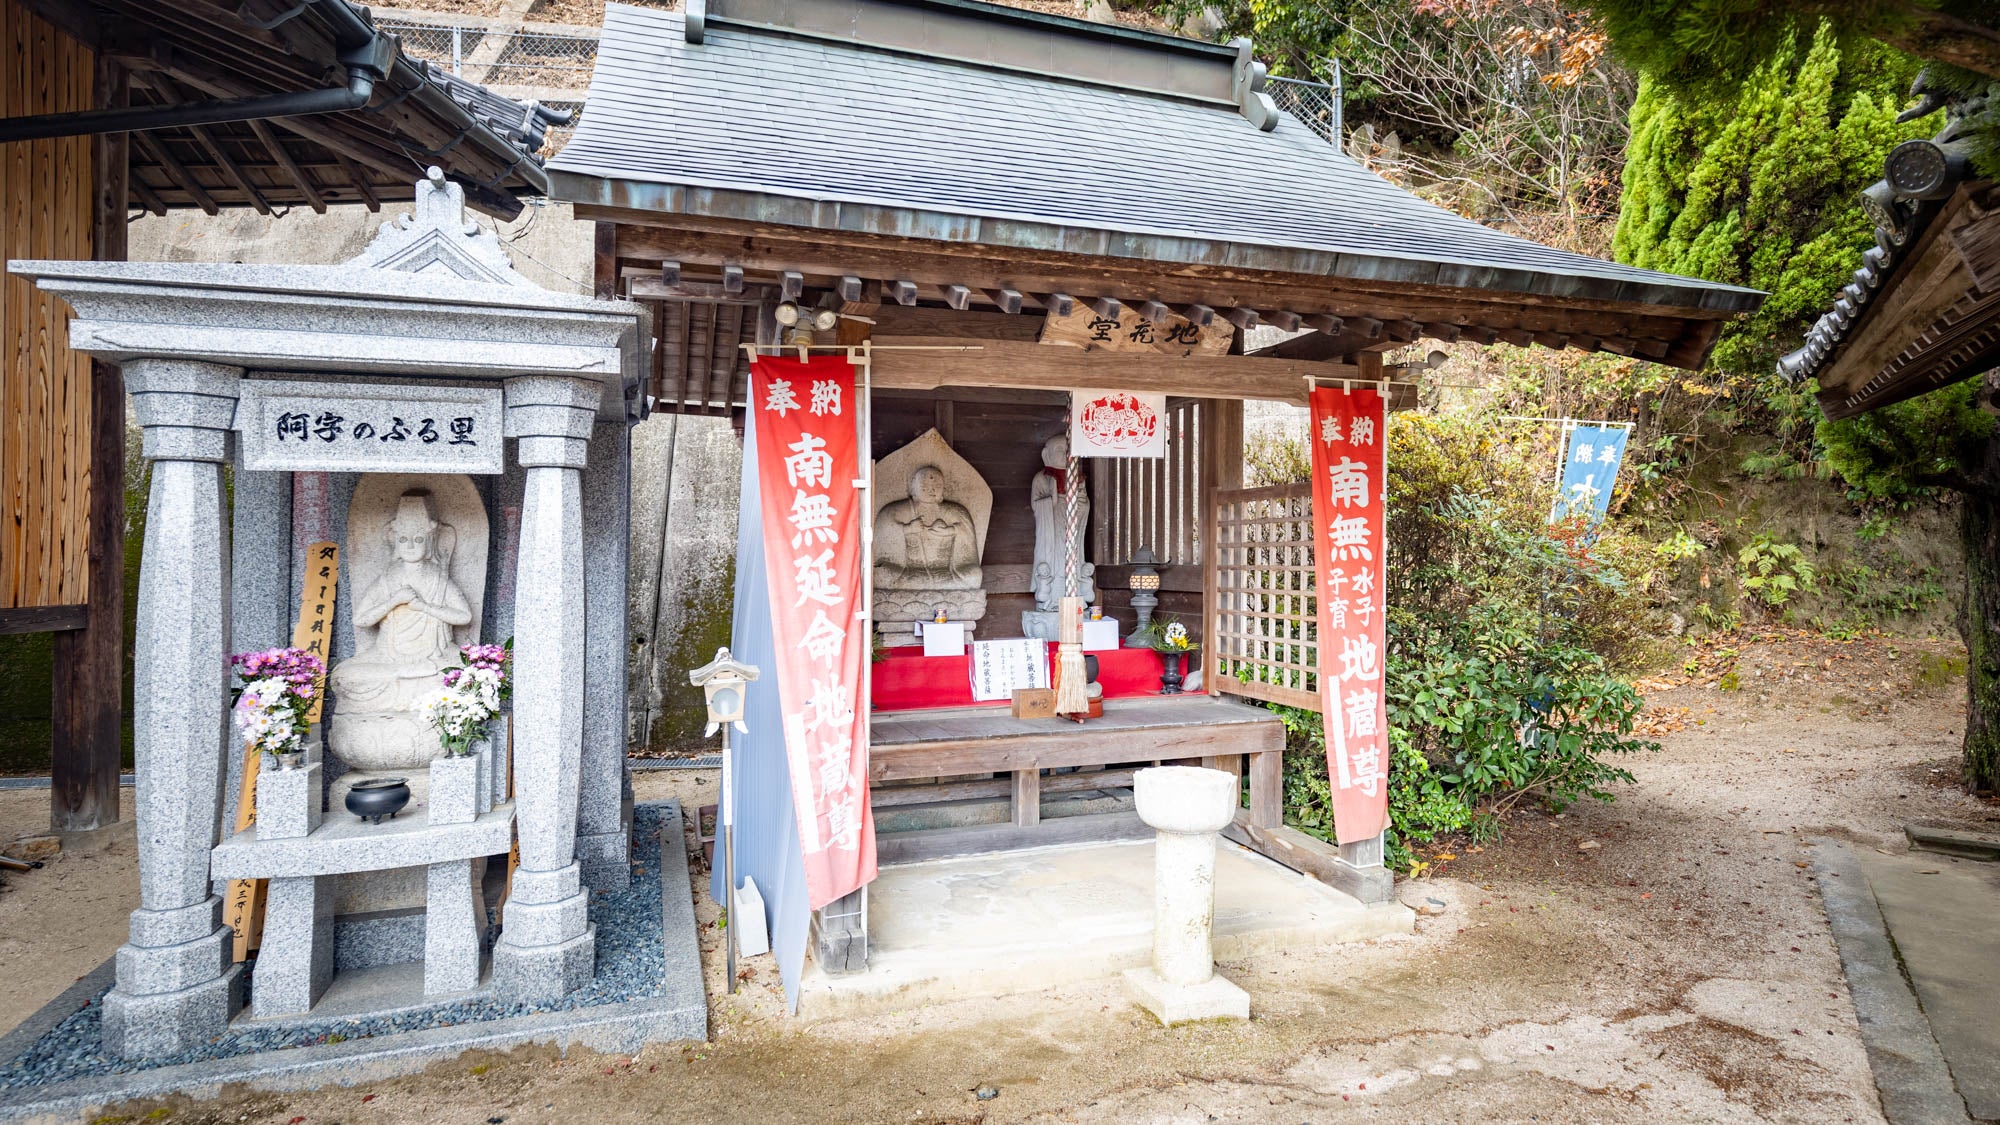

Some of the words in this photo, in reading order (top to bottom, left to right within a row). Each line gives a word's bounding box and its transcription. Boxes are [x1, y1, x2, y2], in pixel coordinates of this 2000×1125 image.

[276, 411, 477, 446] 阿字のふる里
[765, 378, 842, 418] 奉納
[1320, 415, 1375, 448] 奉納
[1328, 456, 1374, 562] 南無
[1327, 568, 1349, 630] 子育
[1352, 566, 1376, 627] 水子
[783, 432, 862, 851] 南無延命地蔵尊
[1338, 634, 1386, 798] 地蔵尊
